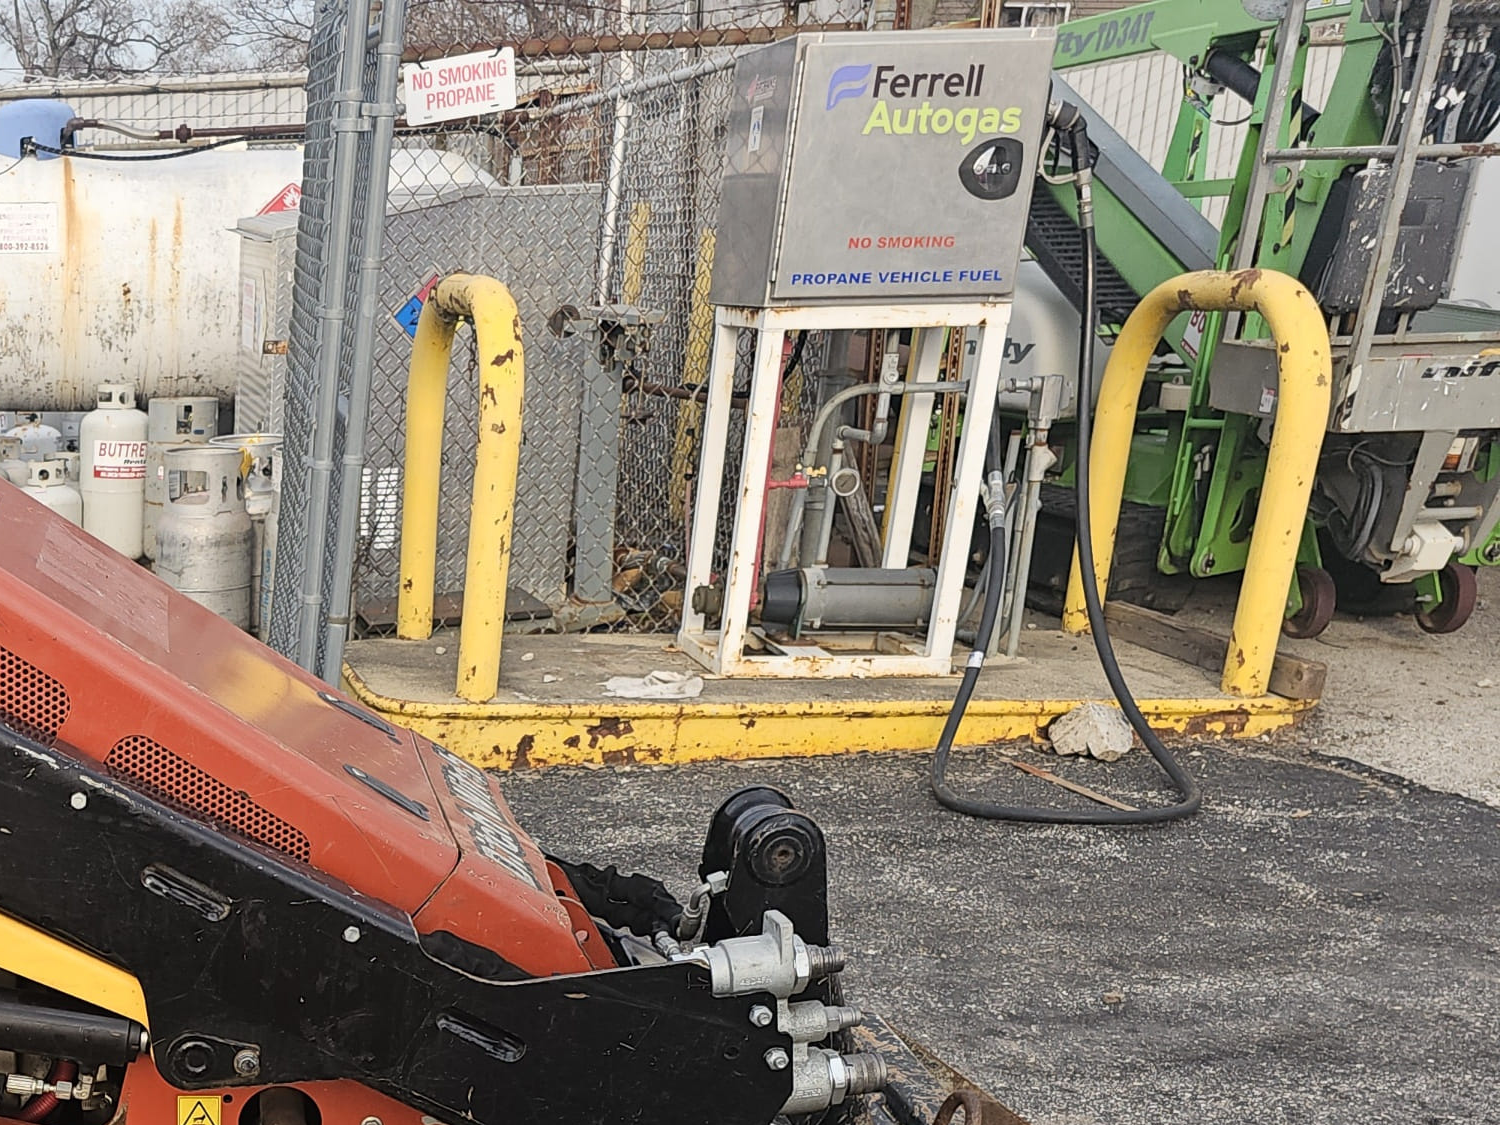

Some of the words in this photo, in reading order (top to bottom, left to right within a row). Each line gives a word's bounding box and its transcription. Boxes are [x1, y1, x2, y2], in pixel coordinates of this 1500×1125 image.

[1053, 31, 1096, 57] fty
[412, 71, 433, 91] NO
[438, 59, 507, 87] SMOKING
[872, 64, 985, 98] Ferrell
[426, 83, 496, 111] PROPANE
[861, 100, 1022, 145] Autogas
[848, 236, 872, 249] NO
[877, 236, 955, 248] SMOKING
[791, 272, 872, 285] PROPANE
[878, 271, 953, 283] VEHICLE
[958, 270, 1003, 282] FUEL
[99, 442, 148, 458] BUTTRE
